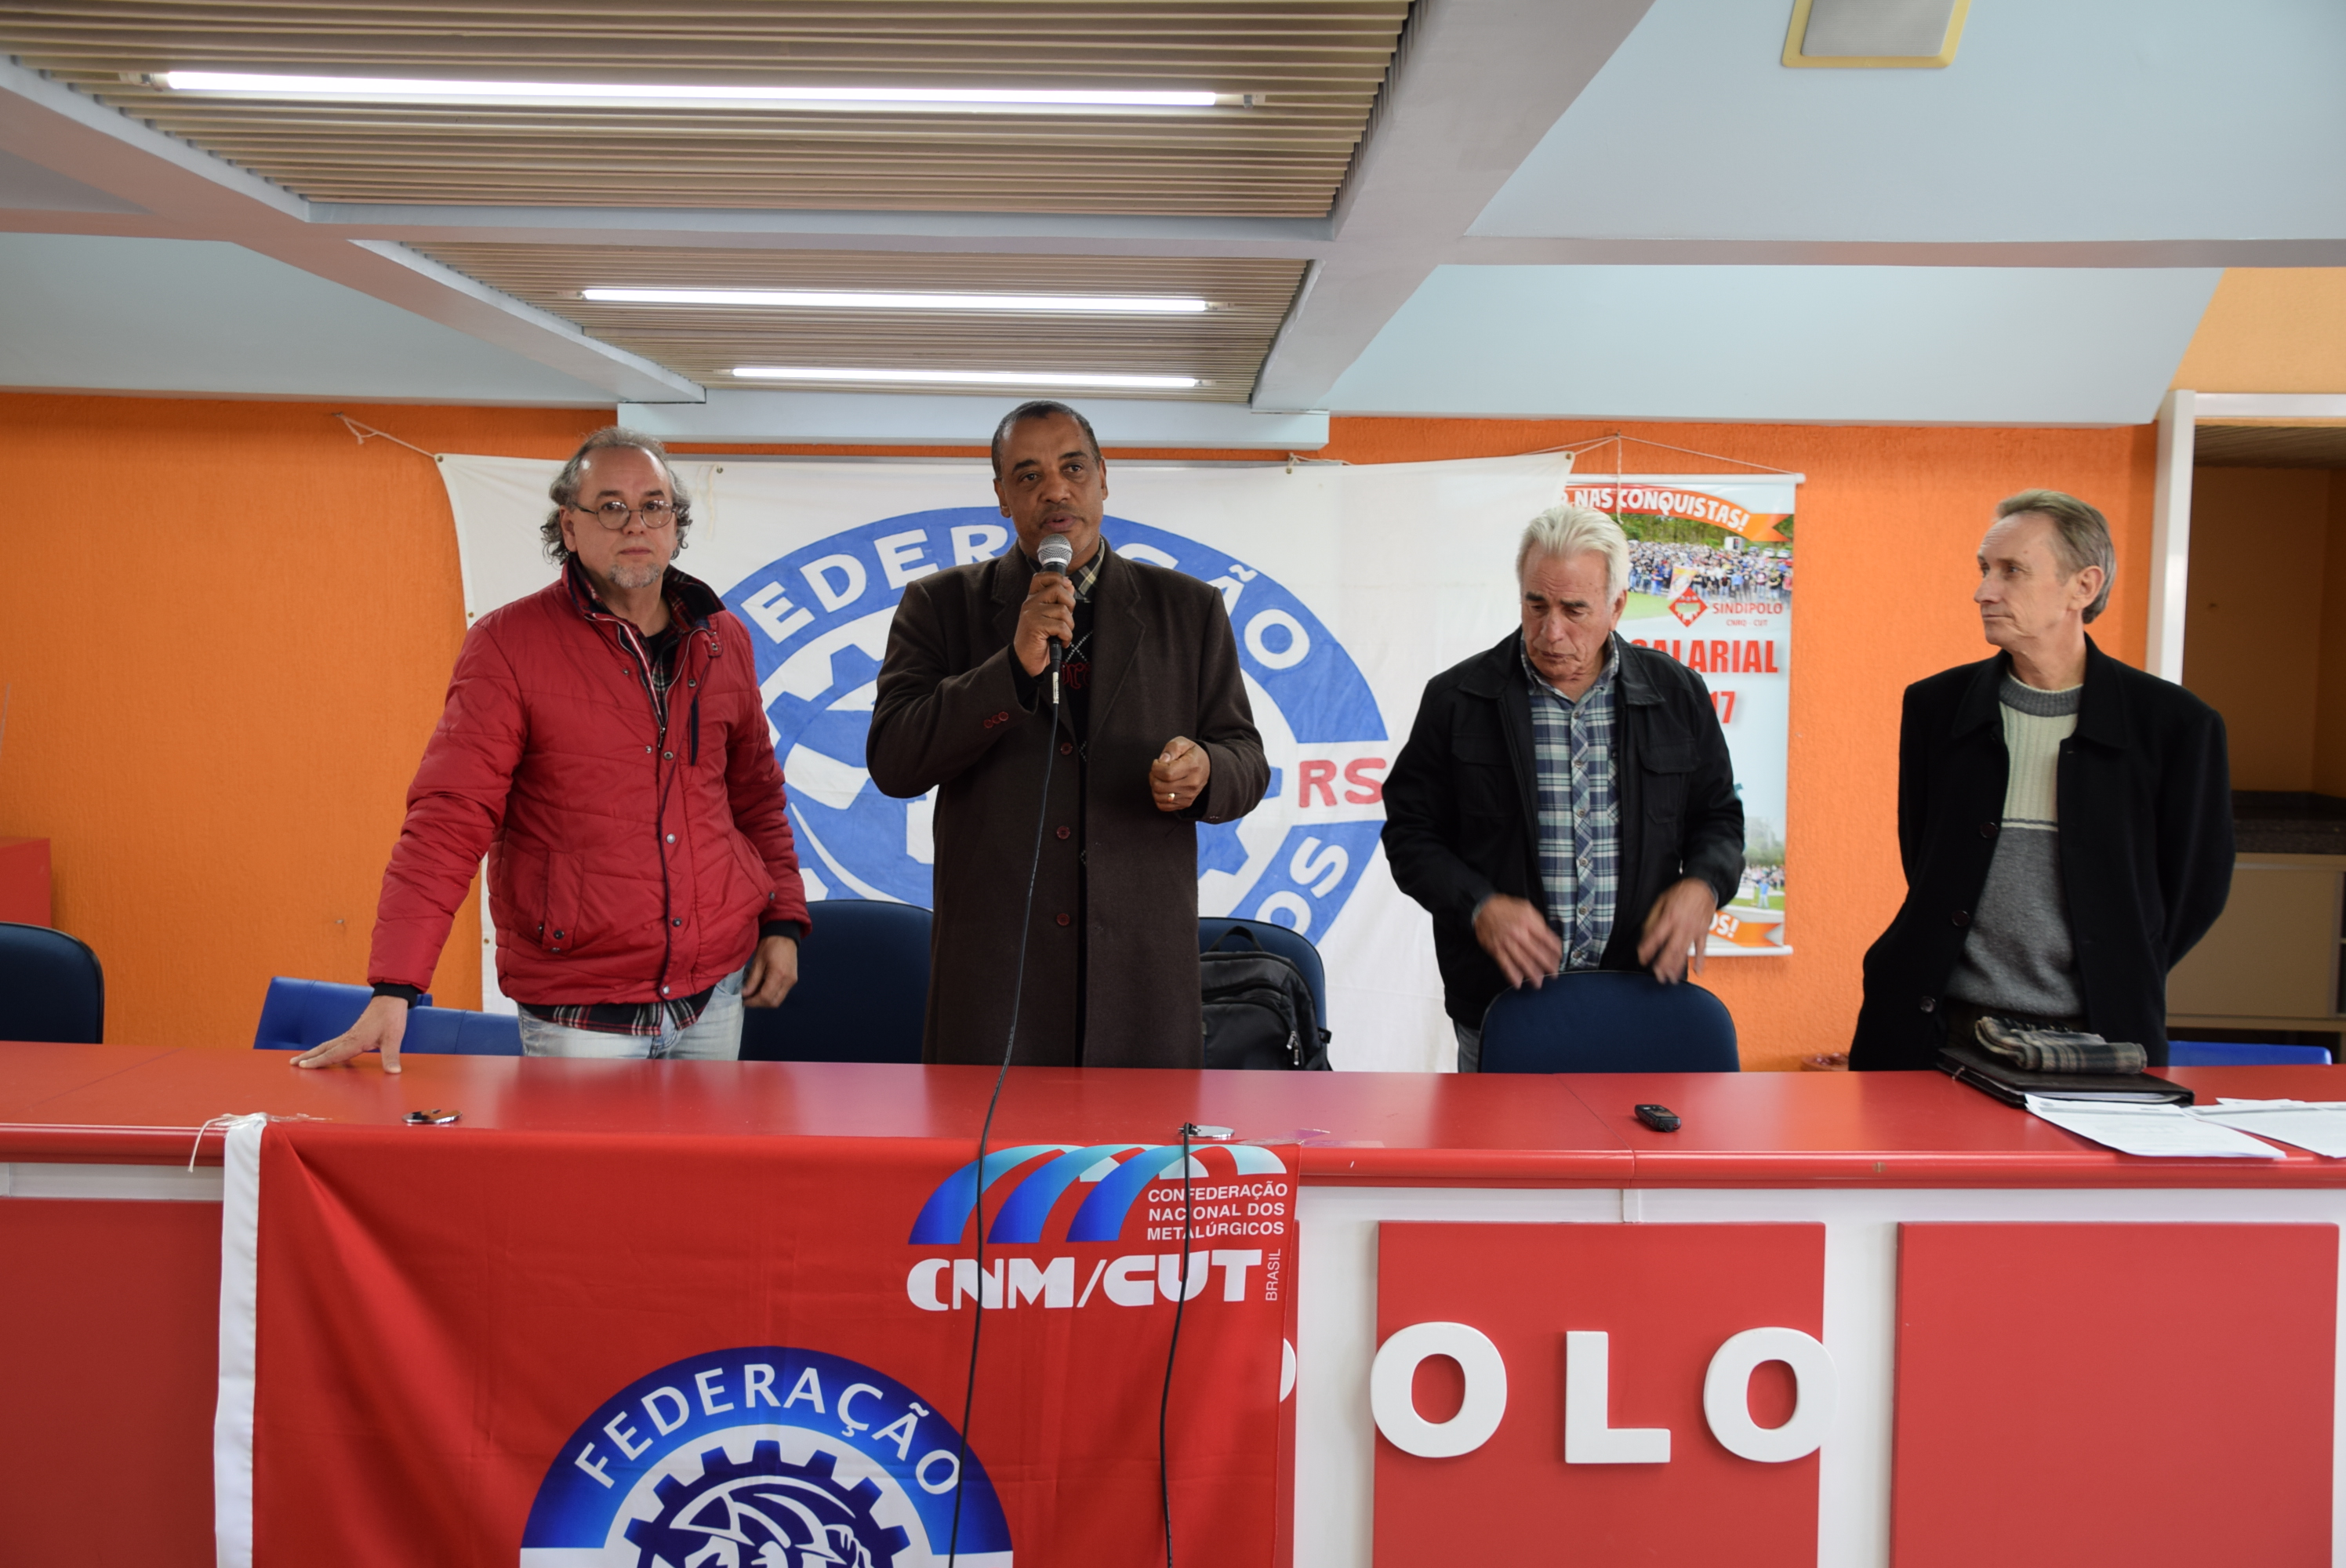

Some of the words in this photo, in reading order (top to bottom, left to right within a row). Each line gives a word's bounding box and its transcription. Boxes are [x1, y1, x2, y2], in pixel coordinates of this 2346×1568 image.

[1574, 488, 1614, 509] NAS
[1616, 488, 1750, 532] CONQUISTAS!
[1712, 602, 1783, 615] SINDIPOLO
[1298, 757, 1387, 808] RS
[1147, 1221, 1284, 1240] METALÚRGICOS
[1149, 1203, 1241, 1221] NACONAL
[1247, 1202, 1284, 1216] DOS
[906, 1249, 1262, 1312] CNM/CUT
[1265, 1248, 1281, 1301] BRASIL
[574, 1363, 960, 1495] FEDERAÇÃO
